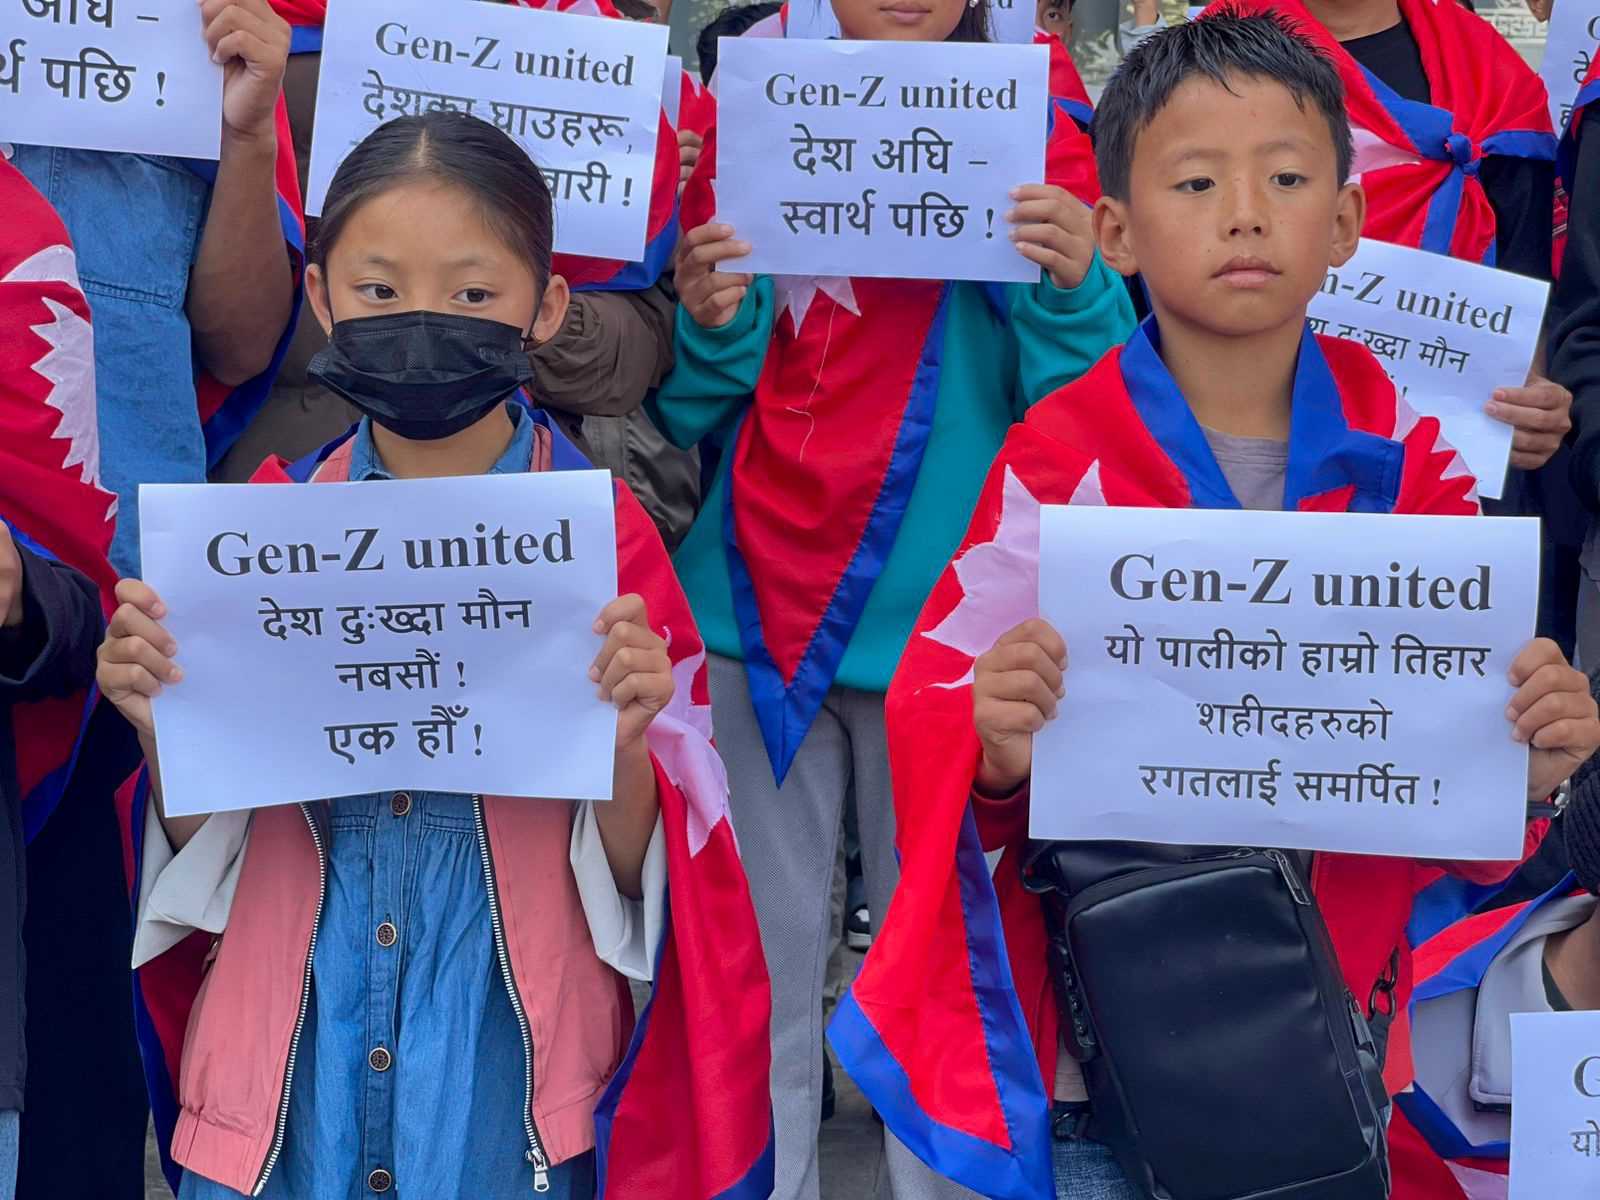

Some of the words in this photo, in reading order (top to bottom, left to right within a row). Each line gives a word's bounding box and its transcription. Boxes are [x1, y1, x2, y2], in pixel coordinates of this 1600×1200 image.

[41, 47, 136, 102] पछि
[375, 22, 500, 70] Gen-Z
[514, 48, 634, 87] united
[766, 74, 887, 108] Gen-Z
[900, 78, 1017, 110] united
[790, 124, 857, 176] देश
[872, 127, 953, 174] अघि
[780, 189, 875, 236] स्वार्थ
[888, 192, 968, 238] पछि
[1321, 271, 1386, 305] n-Z
[1396, 288, 1512, 334] united
[1419, 336, 1470, 373] मौन
[207, 528, 384, 577] Gen-Z
[404, 519, 575, 568] united
[1109, 554, 1291, 604] Gen-Z
[1312, 562, 1492, 610] united
[258, 597, 323, 640] देश
[457, 588, 532, 629] मौन
[335, 649, 440, 691] नबसौं
[1104, 624, 1144, 664] यो
[1156, 628, 1287, 671] पालीको
[1299, 632, 1379, 677] हाम्रो
[1391, 634, 1492, 680] तिहार
[324, 722, 398, 765] एक
[412, 705, 469, 759] हौँ
[1197, 694, 1393, 740] शहीदहरुको
[1139, 759, 1281, 806] रगतलाई
[1293, 763, 1420, 805] समर्पित
